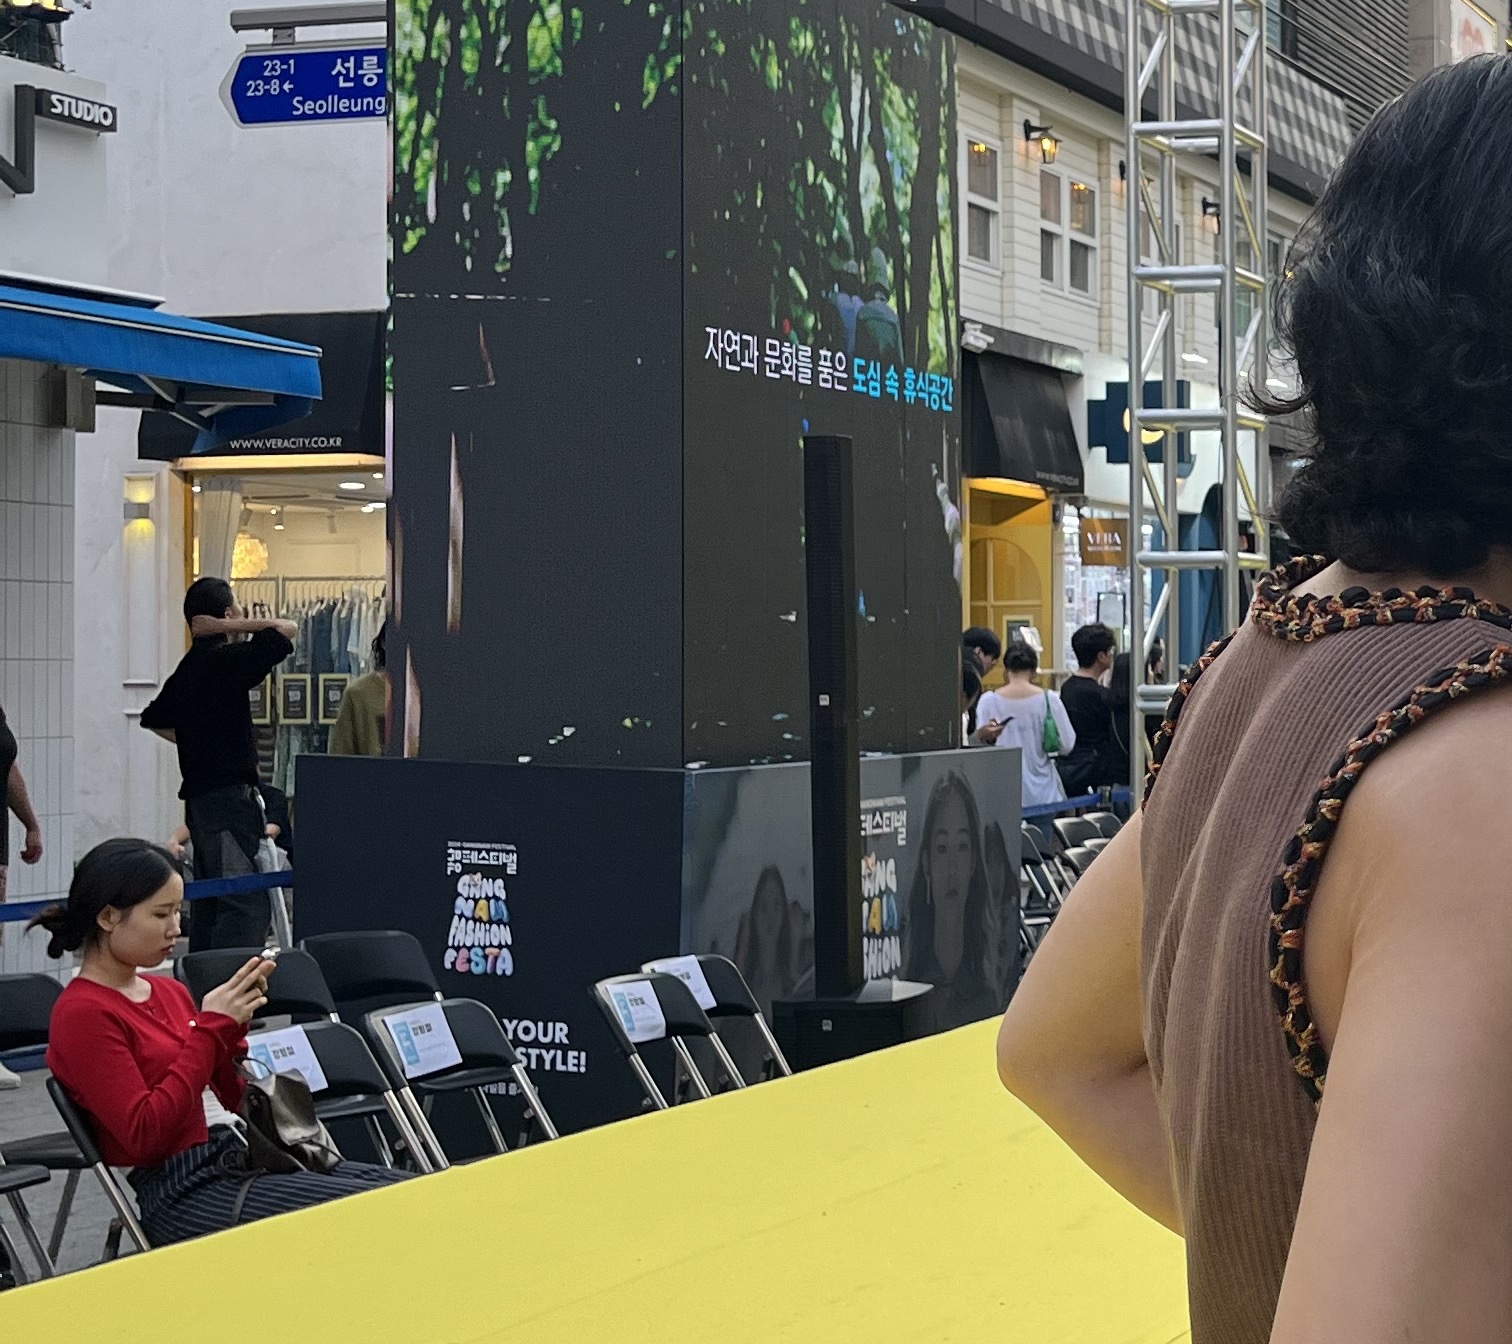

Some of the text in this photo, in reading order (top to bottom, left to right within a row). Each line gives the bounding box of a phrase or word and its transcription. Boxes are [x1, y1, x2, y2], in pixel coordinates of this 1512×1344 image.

[263, 60, 295, 76] 23-1
[331, 56, 384, 88] 선릉
[246, 80, 280, 97] 23-8
[50, 94, 113, 126] STUDIO
[292, 95, 386, 116] Seolleung
[704, 326, 954, 412] 자연과 문화를 품은 도심 속 휴식공간
[230, 437, 342, 449] WWW.VERACITY.CO.KR
[454, 896, 510, 923] NAM
[444, 947, 514, 976] FESTA
[501, 1018, 569, 1045] YOUR
[514, 1046, 587, 1074] STYLE!
